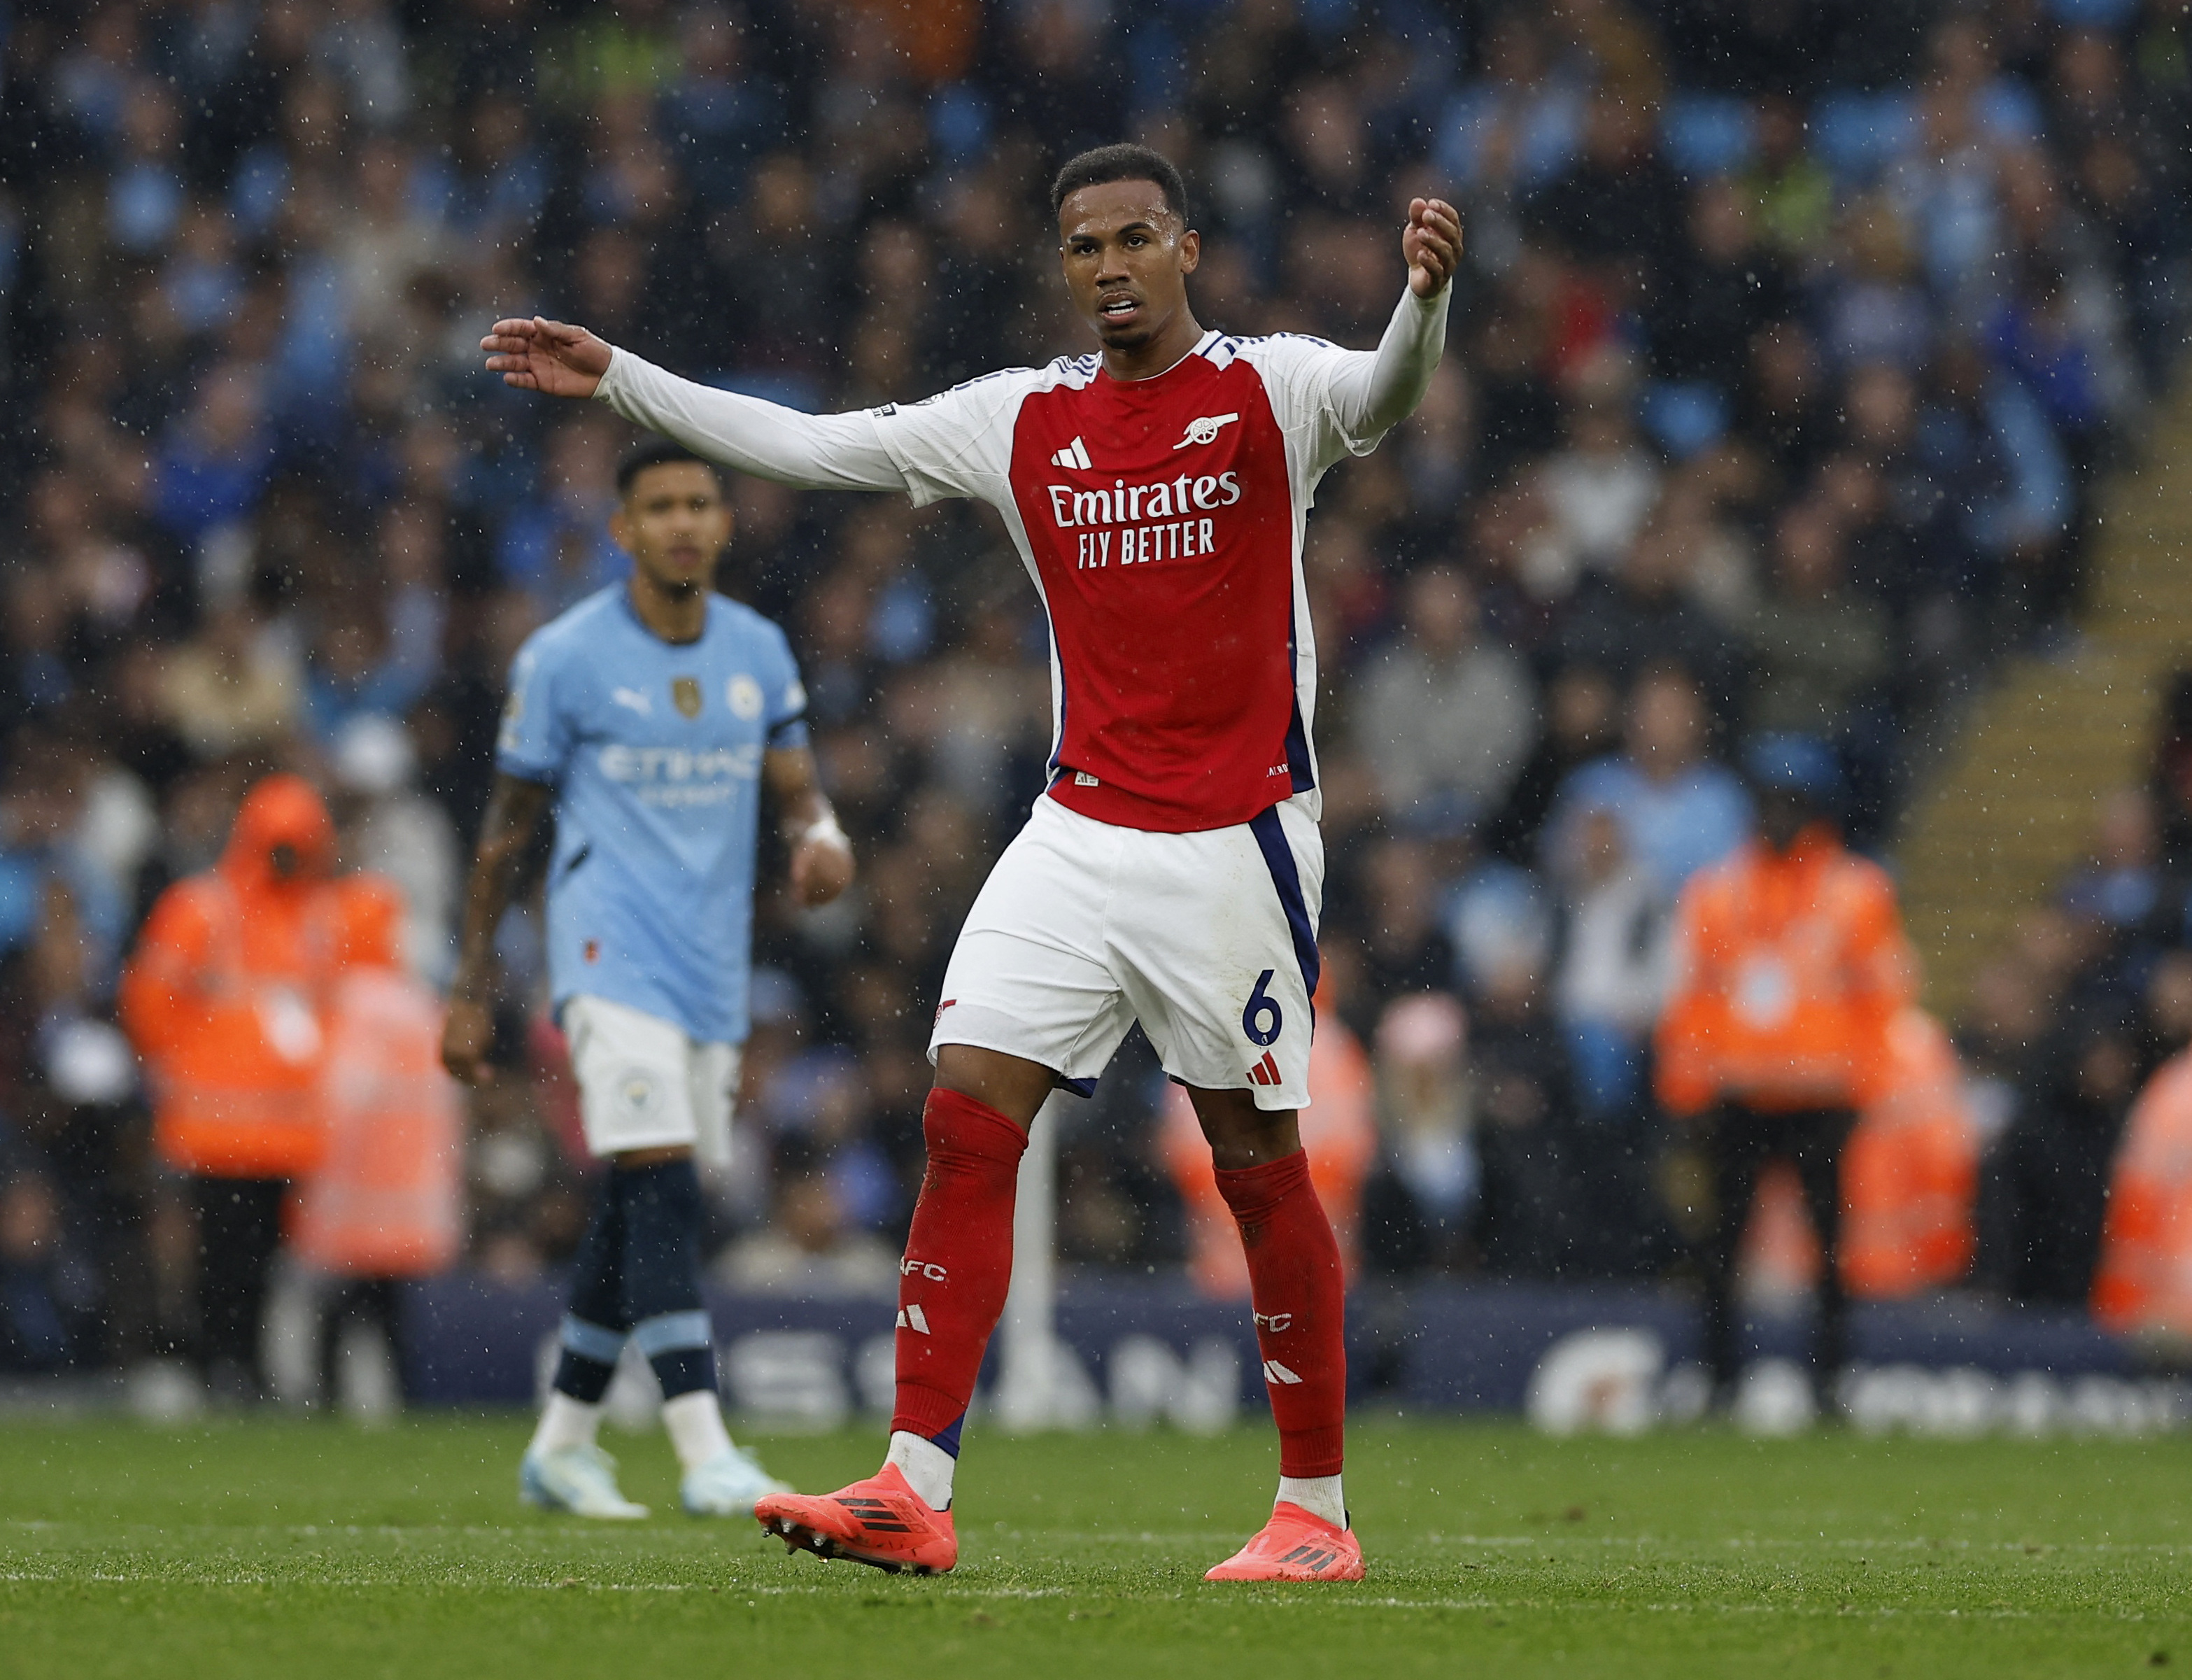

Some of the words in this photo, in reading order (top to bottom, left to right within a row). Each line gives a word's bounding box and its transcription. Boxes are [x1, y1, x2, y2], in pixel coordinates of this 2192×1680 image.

[1047, 471, 1240, 527] Emirates
[1078, 532, 1110, 569] FLY
[1122, 518, 1215, 565] BETTER
[1243, 969, 1282, 1047] 6
[1252, 1307, 1292, 1332] FC
